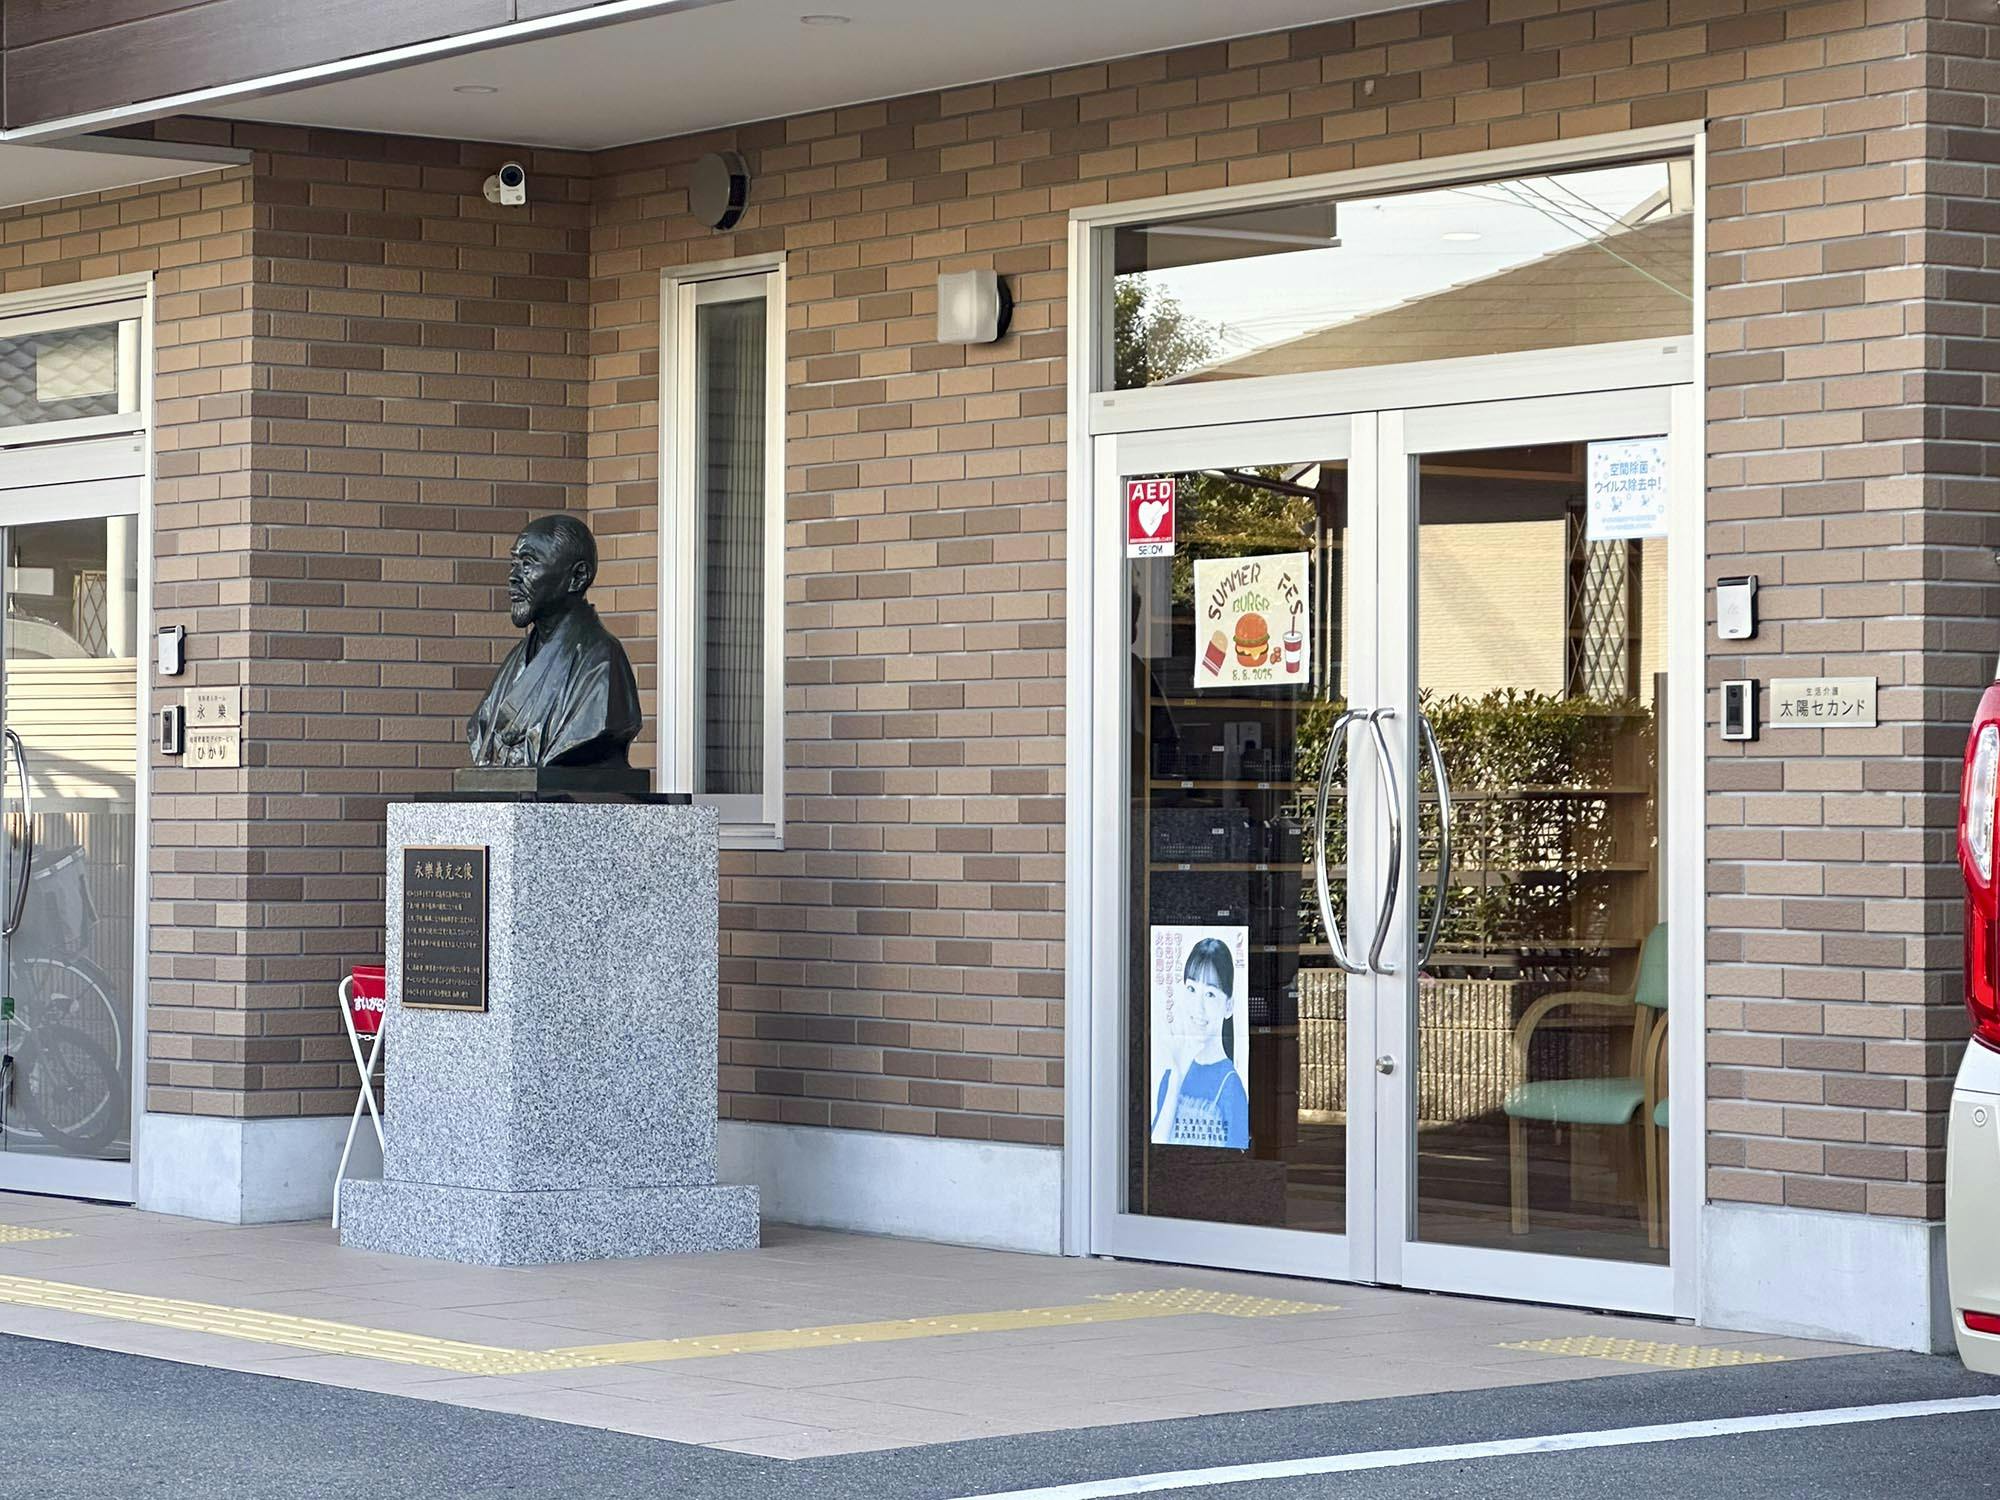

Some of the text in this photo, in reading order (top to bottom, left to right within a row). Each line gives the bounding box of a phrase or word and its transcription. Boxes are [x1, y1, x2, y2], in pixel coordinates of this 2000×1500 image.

[1610, 460, 1649, 476] 空間除菌
[1131, 482, 1171, 501] AED
[1207, 562, 1304, 620] SUMMER FES
[1806, 687, 1839, 696] 生活介護
[1780, 699, 1865, 717] 太陽セカンド
[198, 745, 226, 760] ひかり
[354, 995, 386, 1013] すいがら
